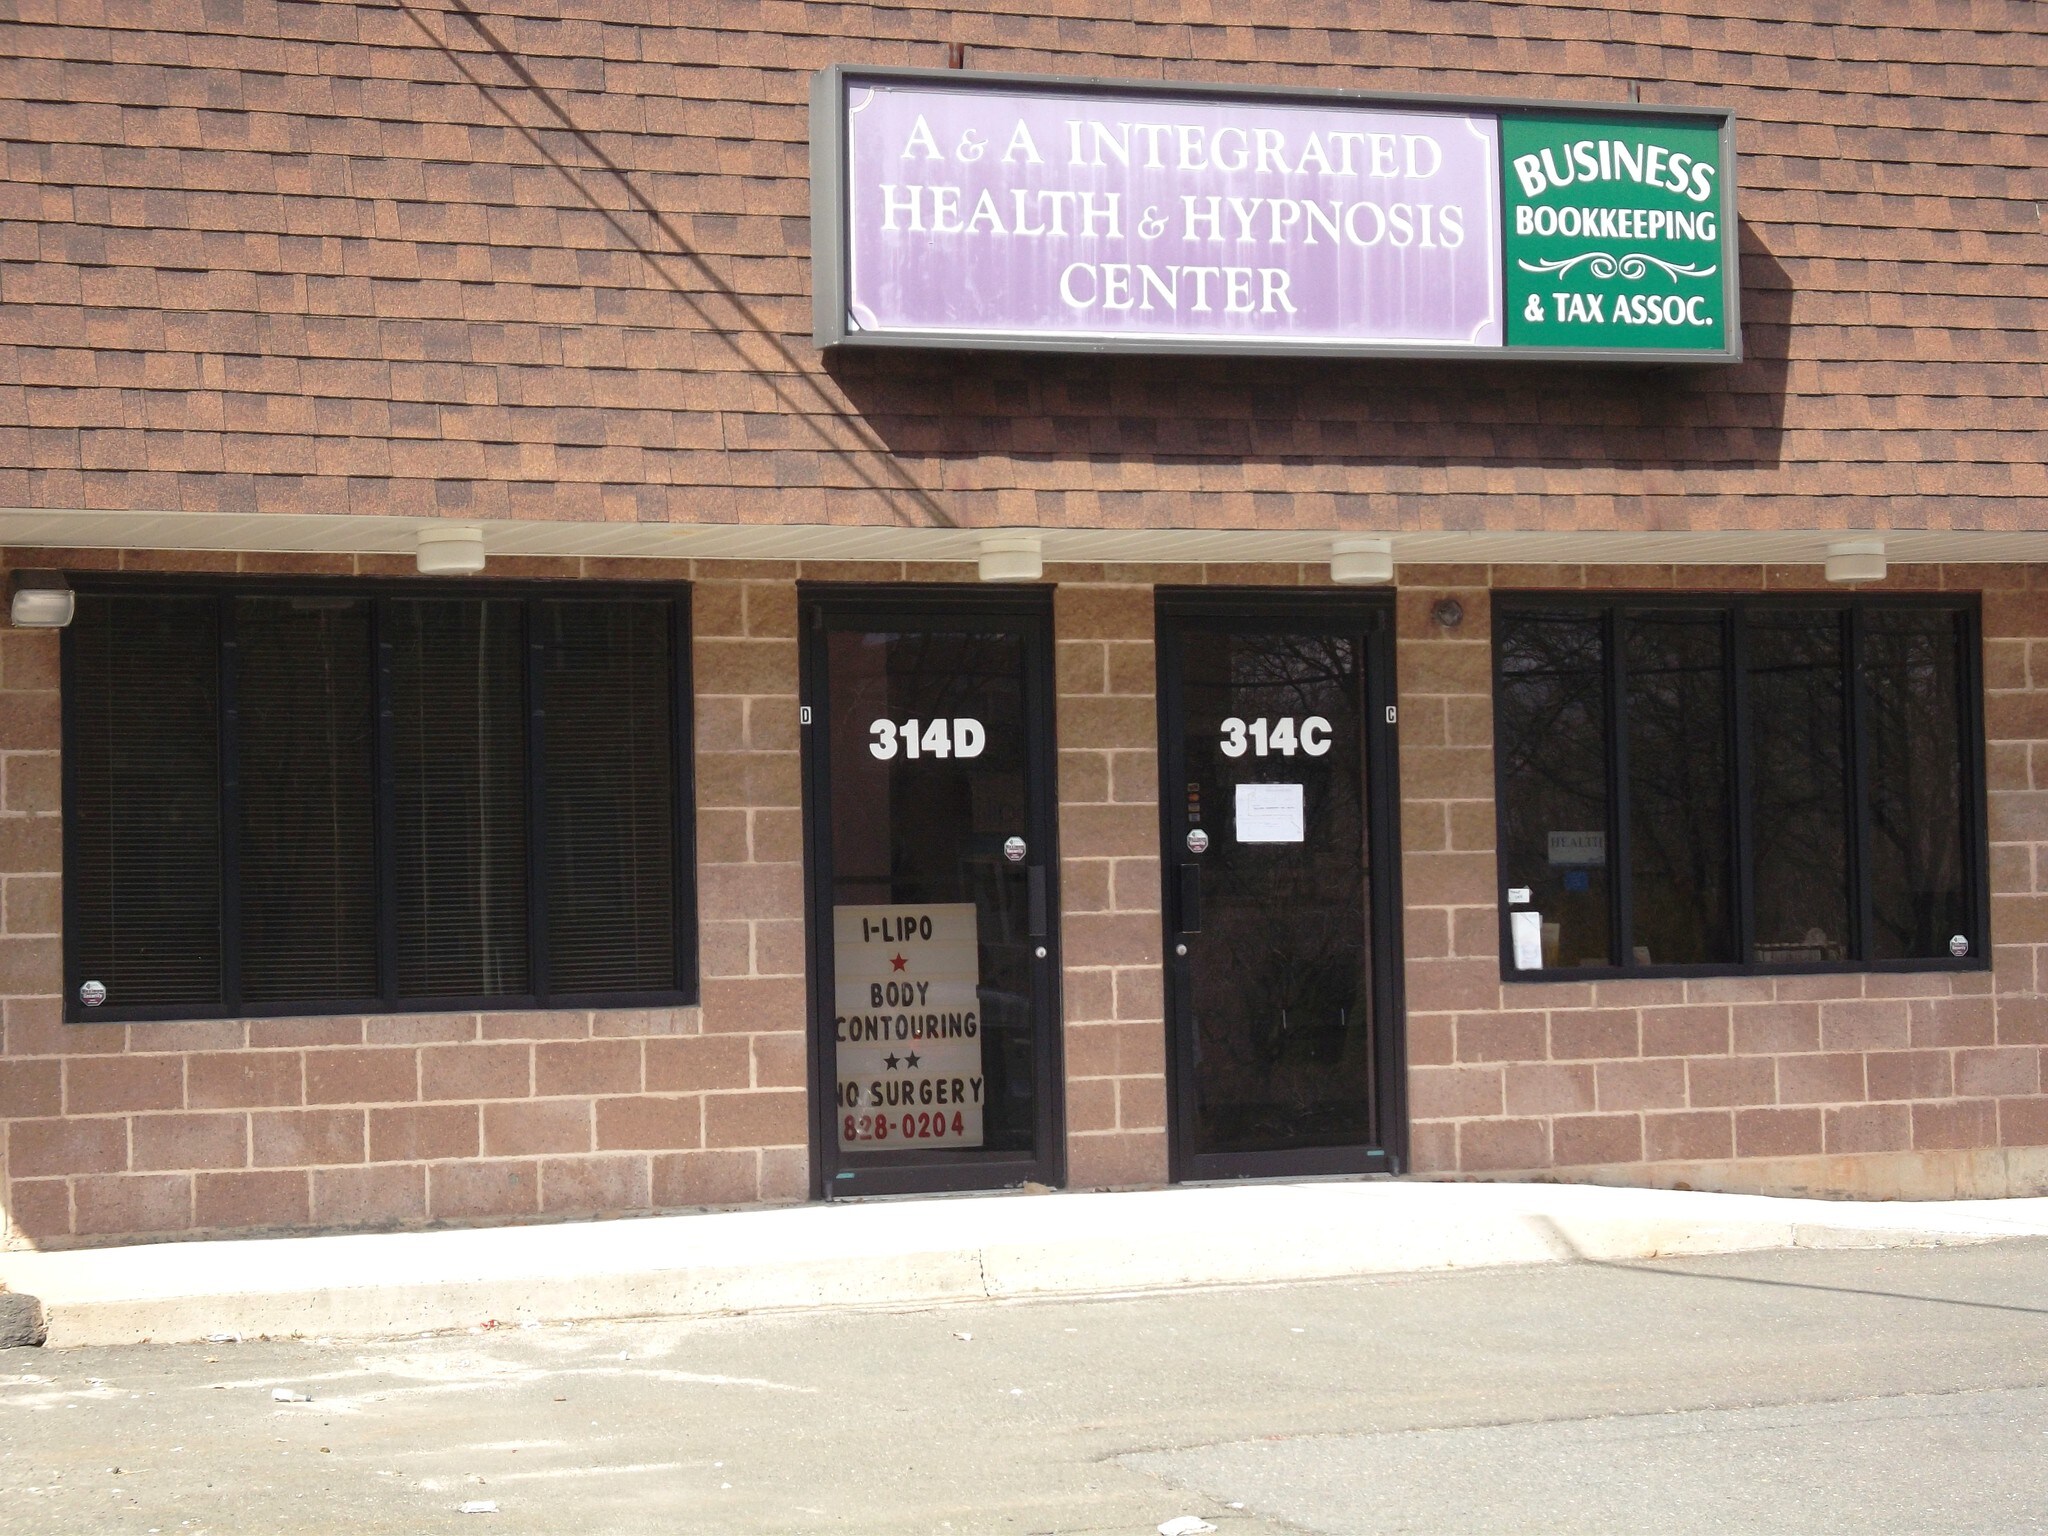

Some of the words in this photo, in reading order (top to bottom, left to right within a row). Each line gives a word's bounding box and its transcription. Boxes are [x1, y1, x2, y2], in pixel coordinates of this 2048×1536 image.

[901, 114, 943, 160] A
[956, 128, 989, 163] &
[1003, 118, 1044, 165] A
[1065, 119, 1443, 180] INTEGRATED
[1513, 140, 1716, 202] BUSINESS
[878, 184, 1126, 239] HEALTH
[1137, 205, 1169, 240] &
[1180, 195, 1466, 249] HYPNOSIS
[1515, 205, 1717, 241] BOOKKEEPING
[1059, 262, 1298, 314] CENTER
[1524, 293, 1545, 322] &
[1552, 292, 1605, 323] TAX
[1612, 294, 1713, 326] ASSOC.
[801, 707, 810, 723] D
[1387, 706, 1396, 723] C
[869, 718, 986, 760] 314D
[1220, 716, 1333, 757] 314C
[862, 915, 933, 943] I-LIPO
[870, 981, 929, 1009] BODY
[836, 1012, 978, 1042] CONTOURING
[870, 1077, 983, 1107] SURGERY
[843, 1110, 965, 1141] 828-0204
